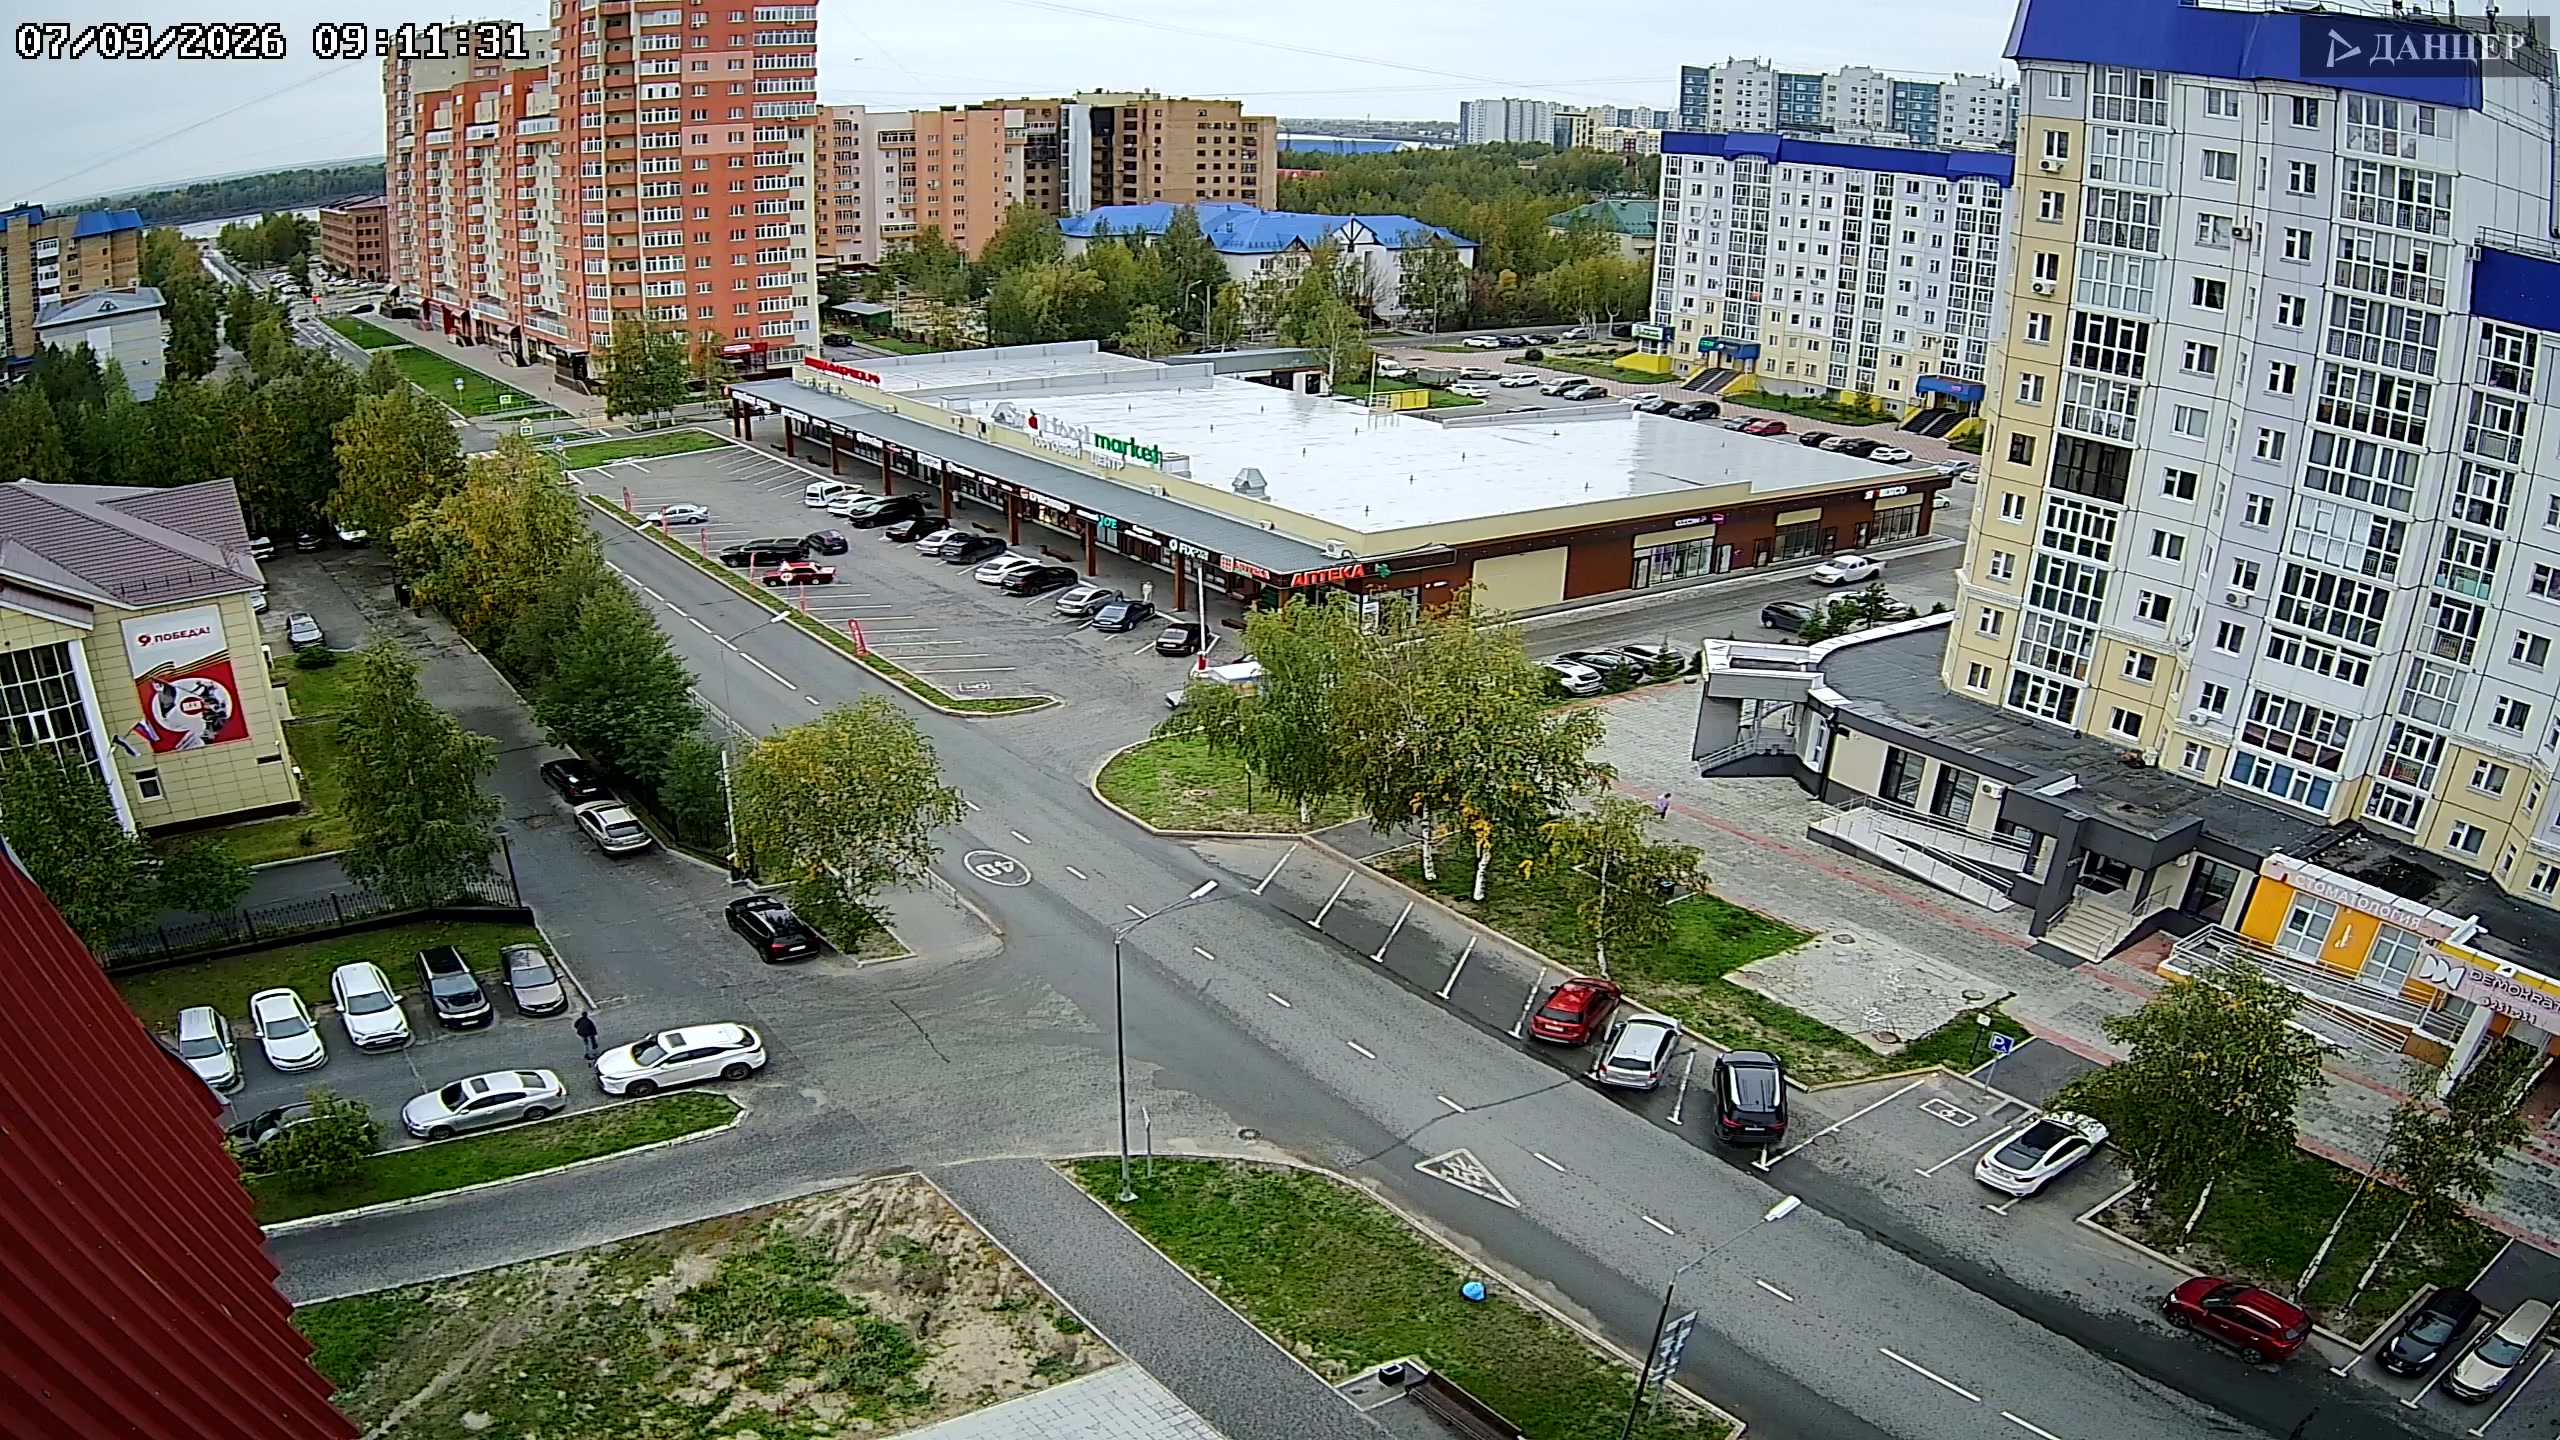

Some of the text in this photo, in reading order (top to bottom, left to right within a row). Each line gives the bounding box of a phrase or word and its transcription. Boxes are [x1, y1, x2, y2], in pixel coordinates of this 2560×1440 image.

[1094, 432, 1160, 464] market
[1290, 563, 1365, 587] АПТЕКА
[154, 626, 211, 643] ПОБЕДА!
[2295, 874, 2421, 931] СТОМАТОЛОГИЯ
[1992, 1035, 2005, 1048] P
